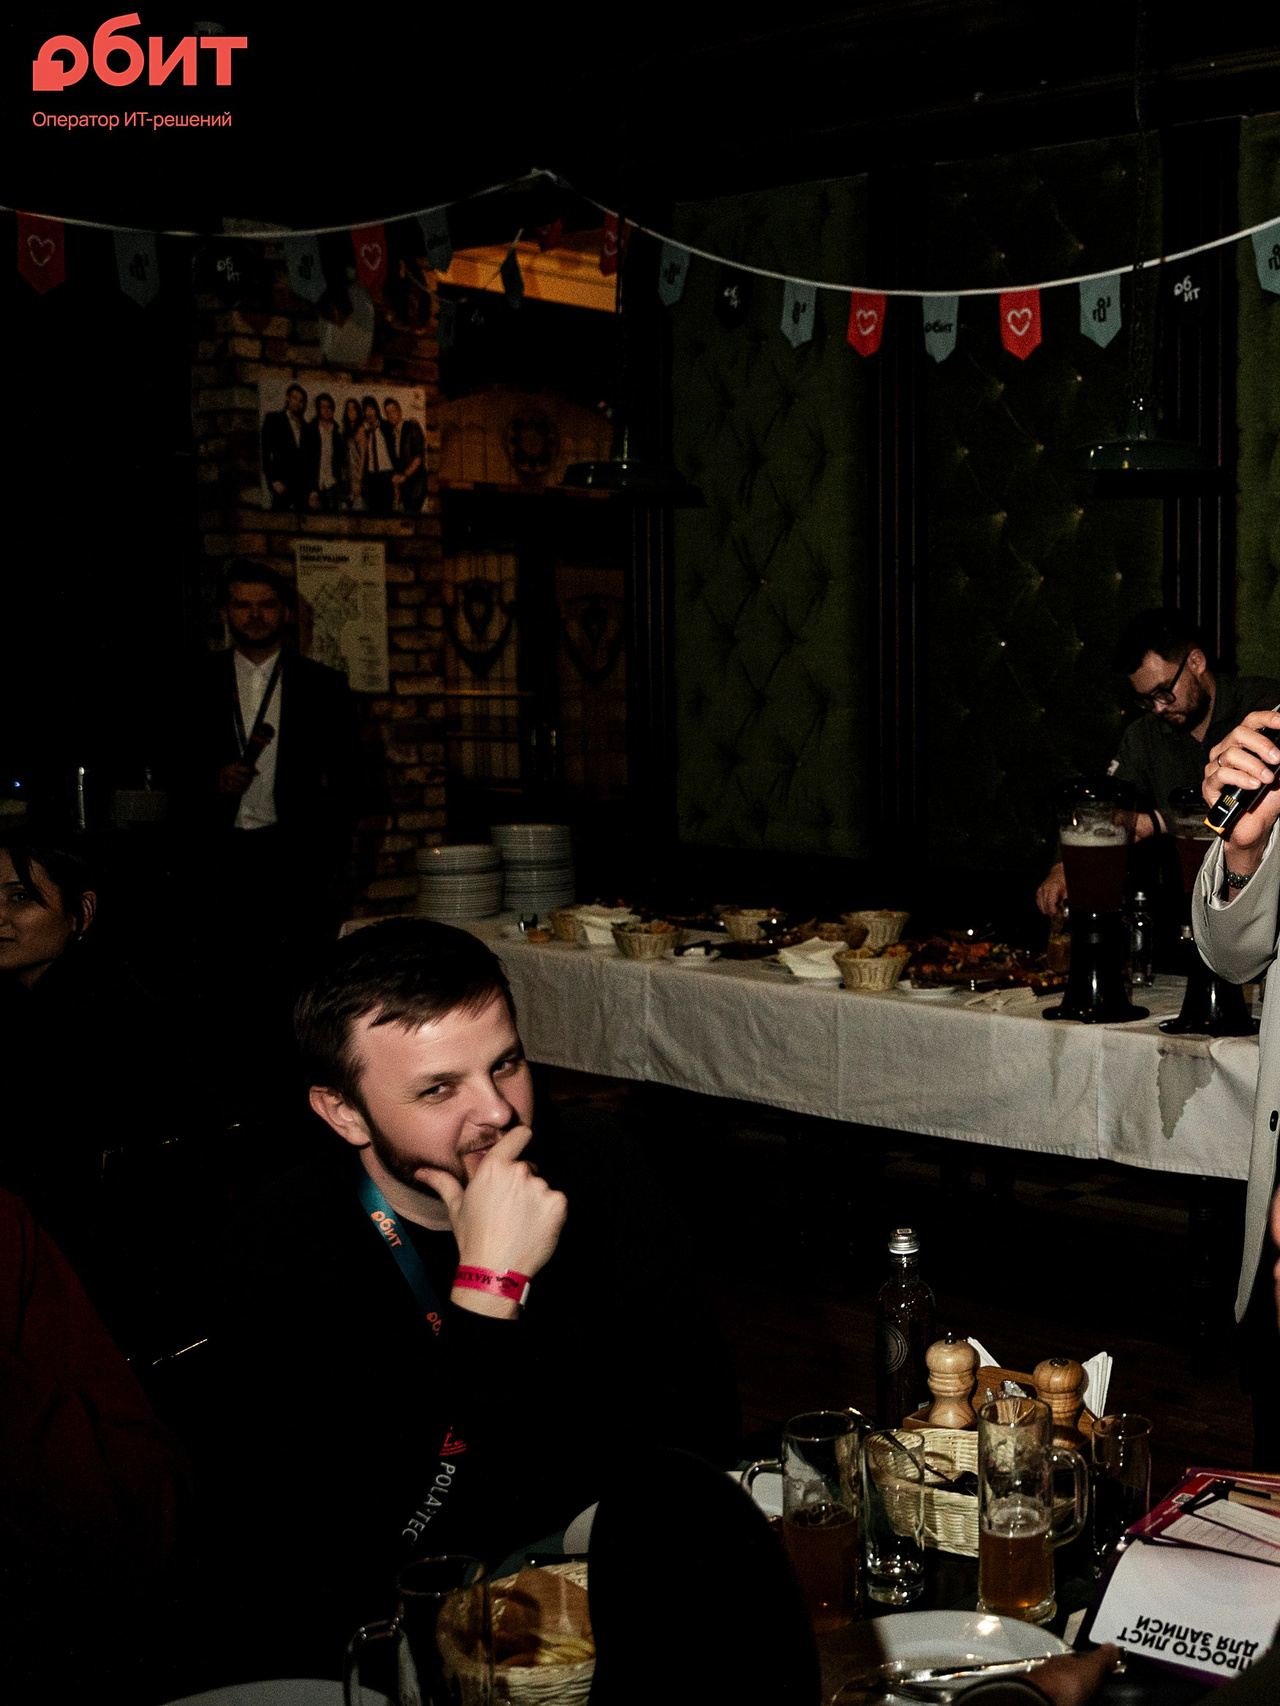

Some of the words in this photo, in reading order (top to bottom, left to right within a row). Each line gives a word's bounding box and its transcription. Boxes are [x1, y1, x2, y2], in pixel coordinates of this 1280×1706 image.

[1117, 1627, 1168, 1650] ЛИСТ
[1136, 1615, 1213, 1647] ЗАПИСИ
[1217, 1635, 1259, 1657] ДЛЯ
